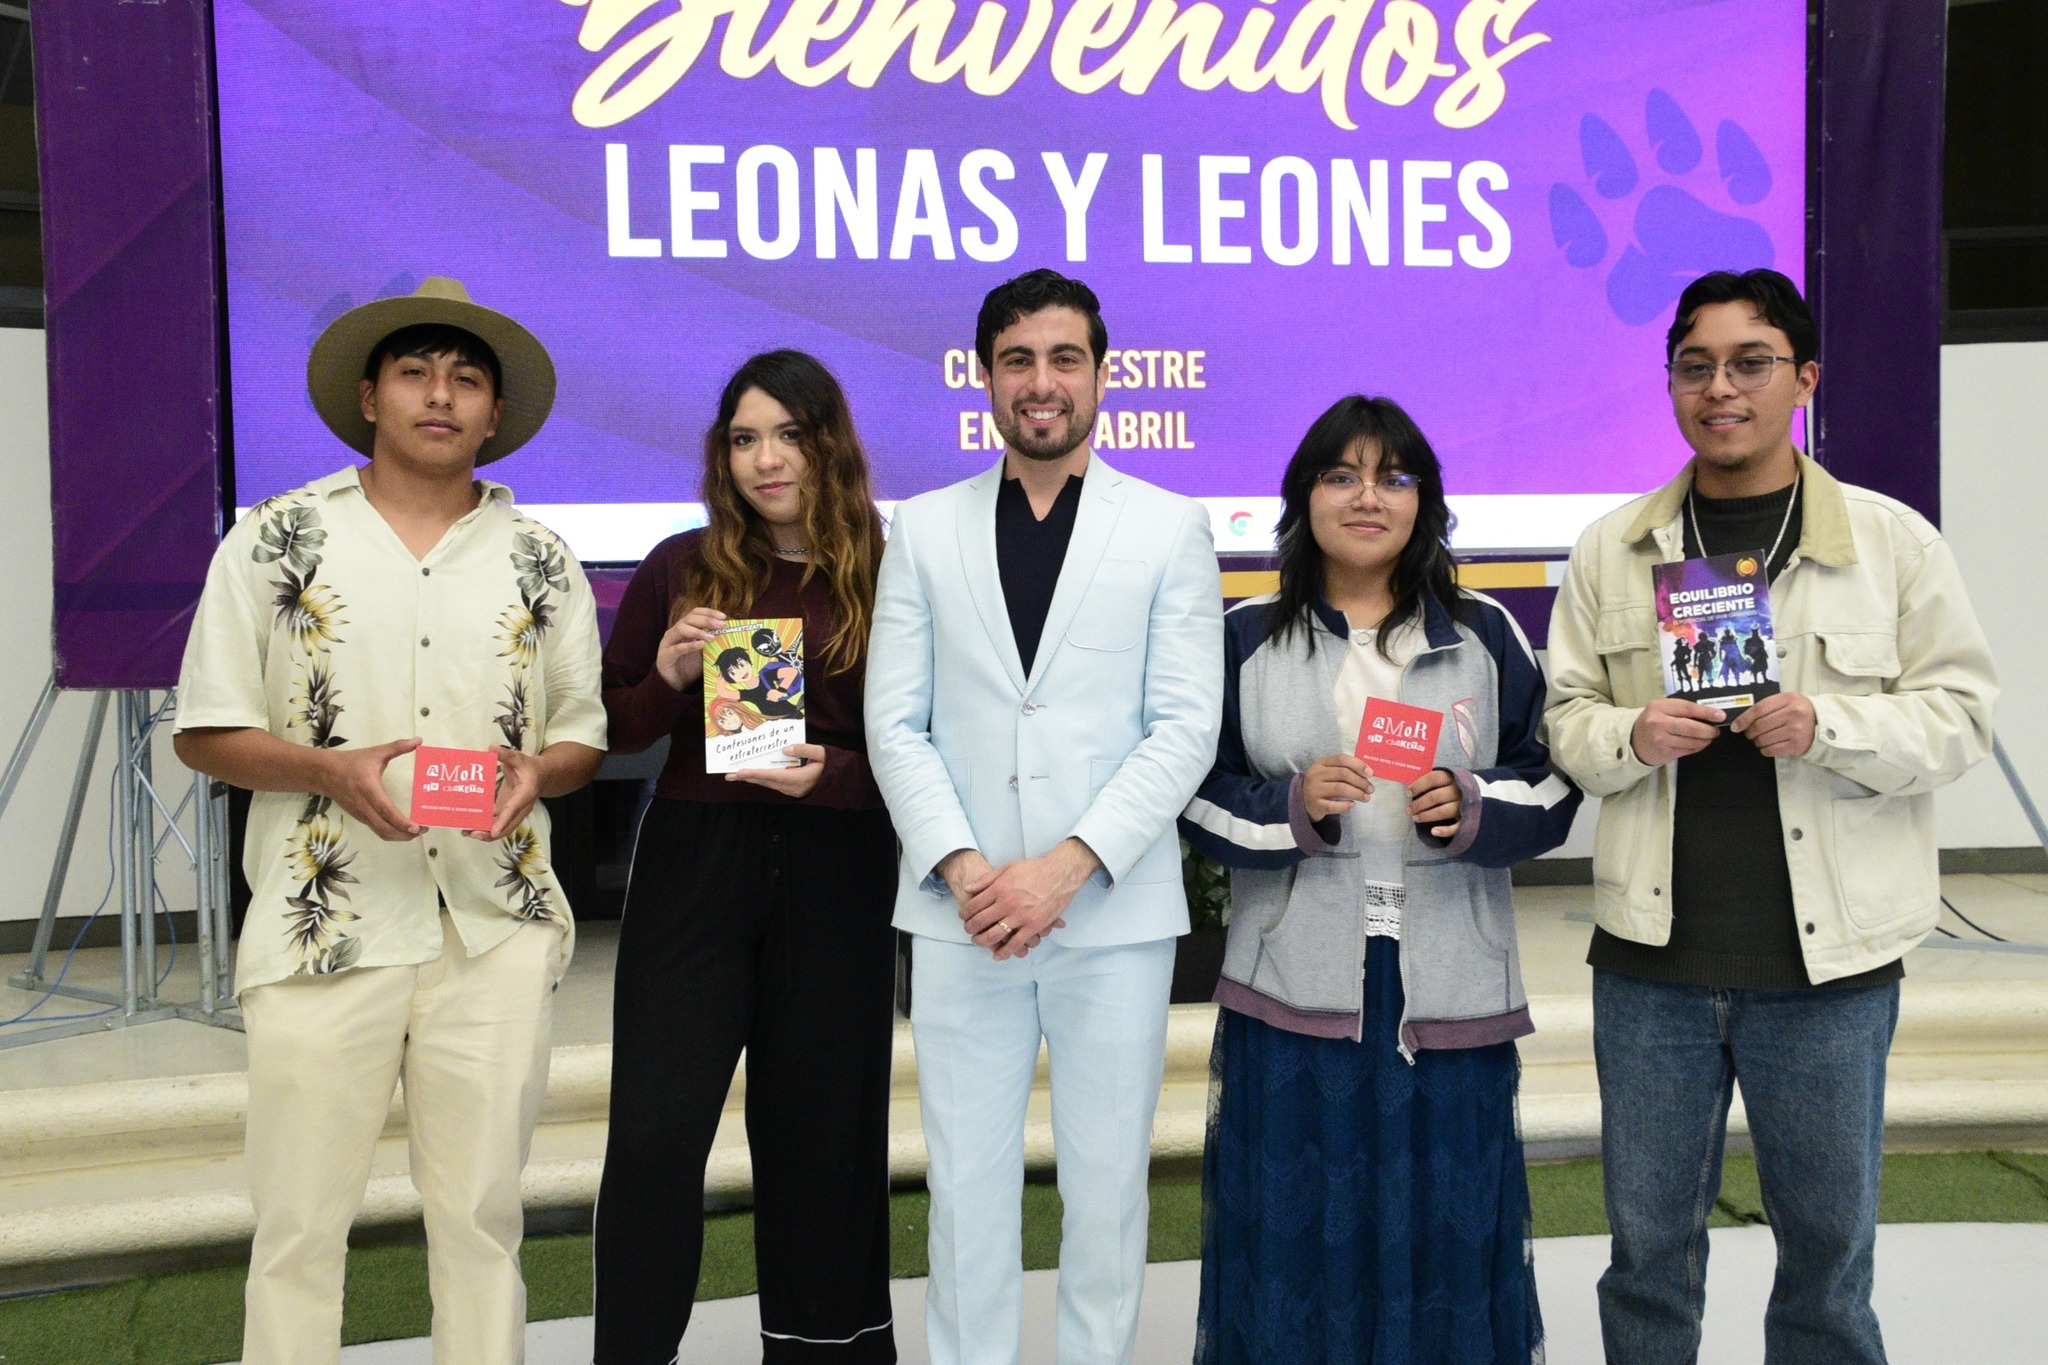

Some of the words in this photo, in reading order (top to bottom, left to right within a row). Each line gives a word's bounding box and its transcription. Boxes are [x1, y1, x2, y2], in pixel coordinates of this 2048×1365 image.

[605, 143, 1019, 262] LEONAS
[1041, 151, 1108, 262] Y
[1142, 153, 1511, 269] LEONES
[1669, 582, 1755, 605] EQUILIBRIO
[1672, 597, 1756, 619] CRECIENTE
[716, 733, 766, 754] Confesiones
[769, 727, 780, 738] de
[783, 725, 795, 733] un
[729, 738, 788, 761] extraterrestre
